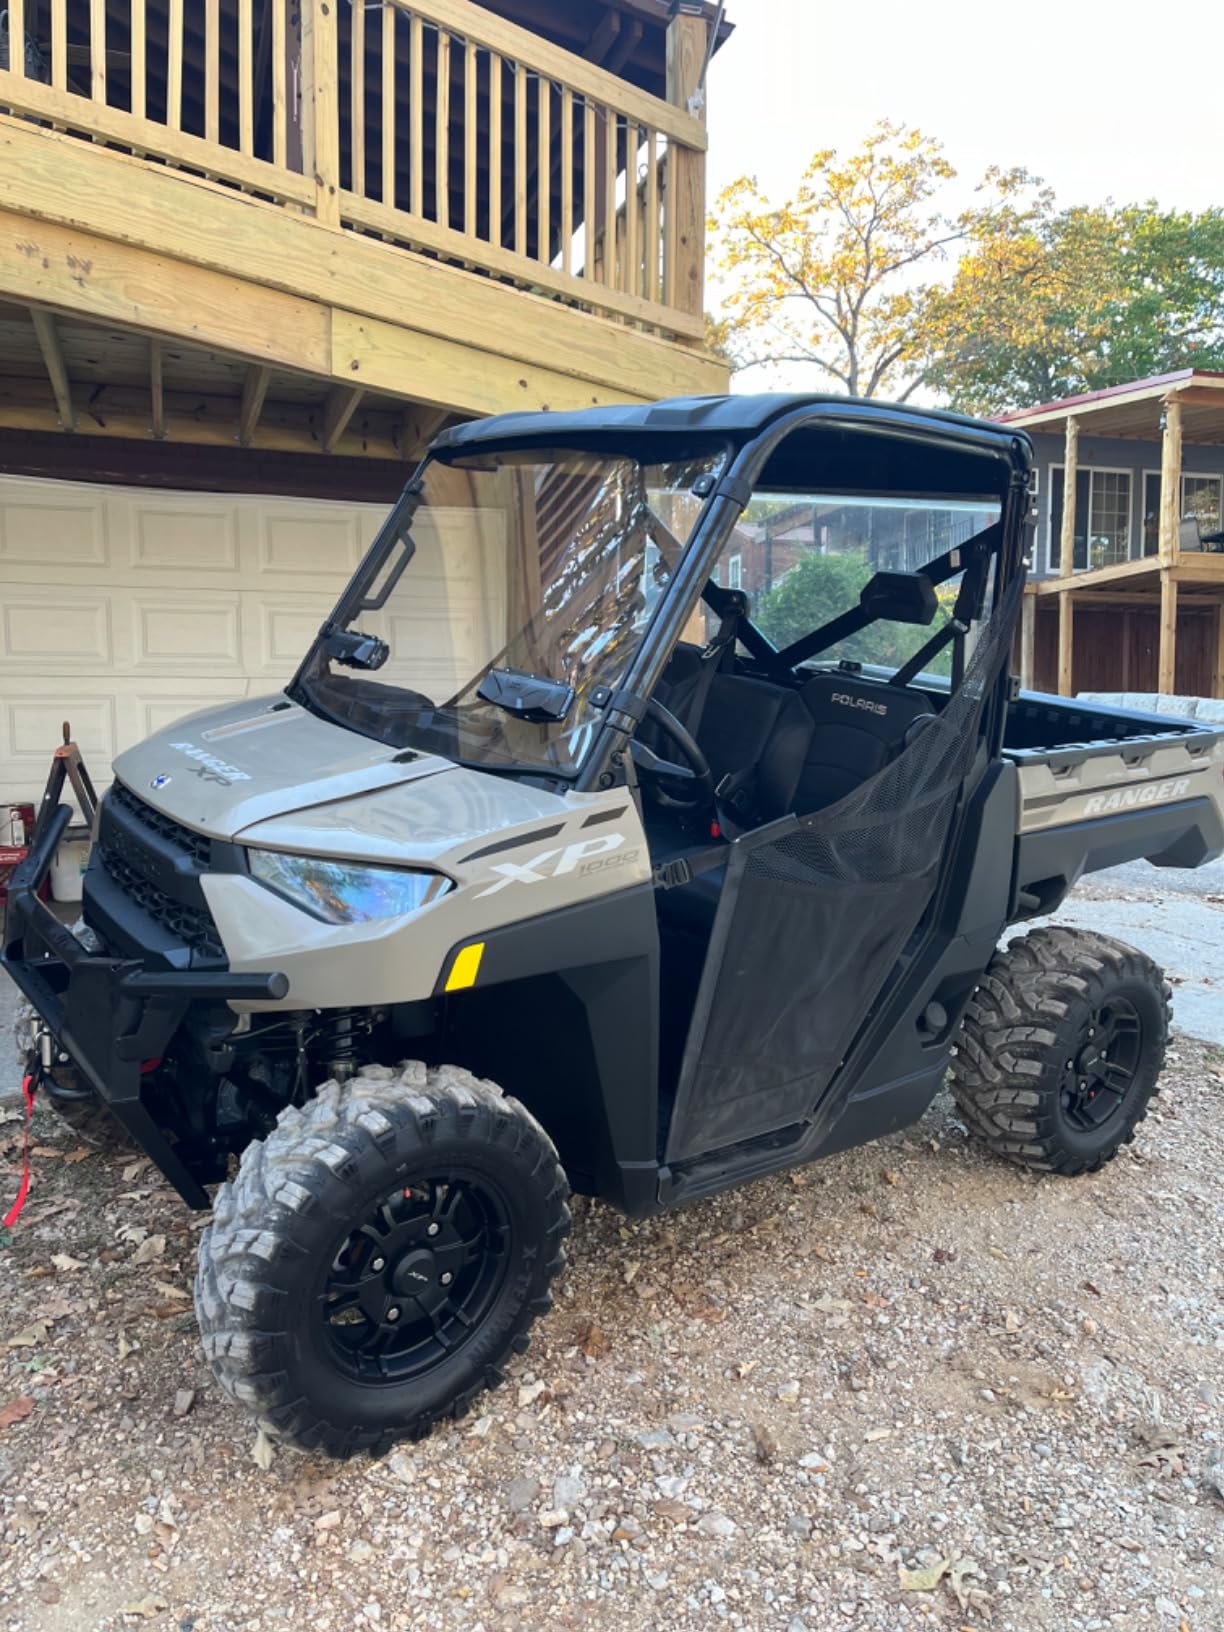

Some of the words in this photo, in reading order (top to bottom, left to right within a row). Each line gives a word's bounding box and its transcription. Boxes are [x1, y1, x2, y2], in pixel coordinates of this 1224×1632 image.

[831, 692, 888, 716] POLARIS
[169, 743, 253, 780] RANGER
[185, 767, 232, 787] XP
[1084, 779, 1191, 816] RANGER
[472, 832, 626, 900] XP
[577, 850, 640, 878] 1000
